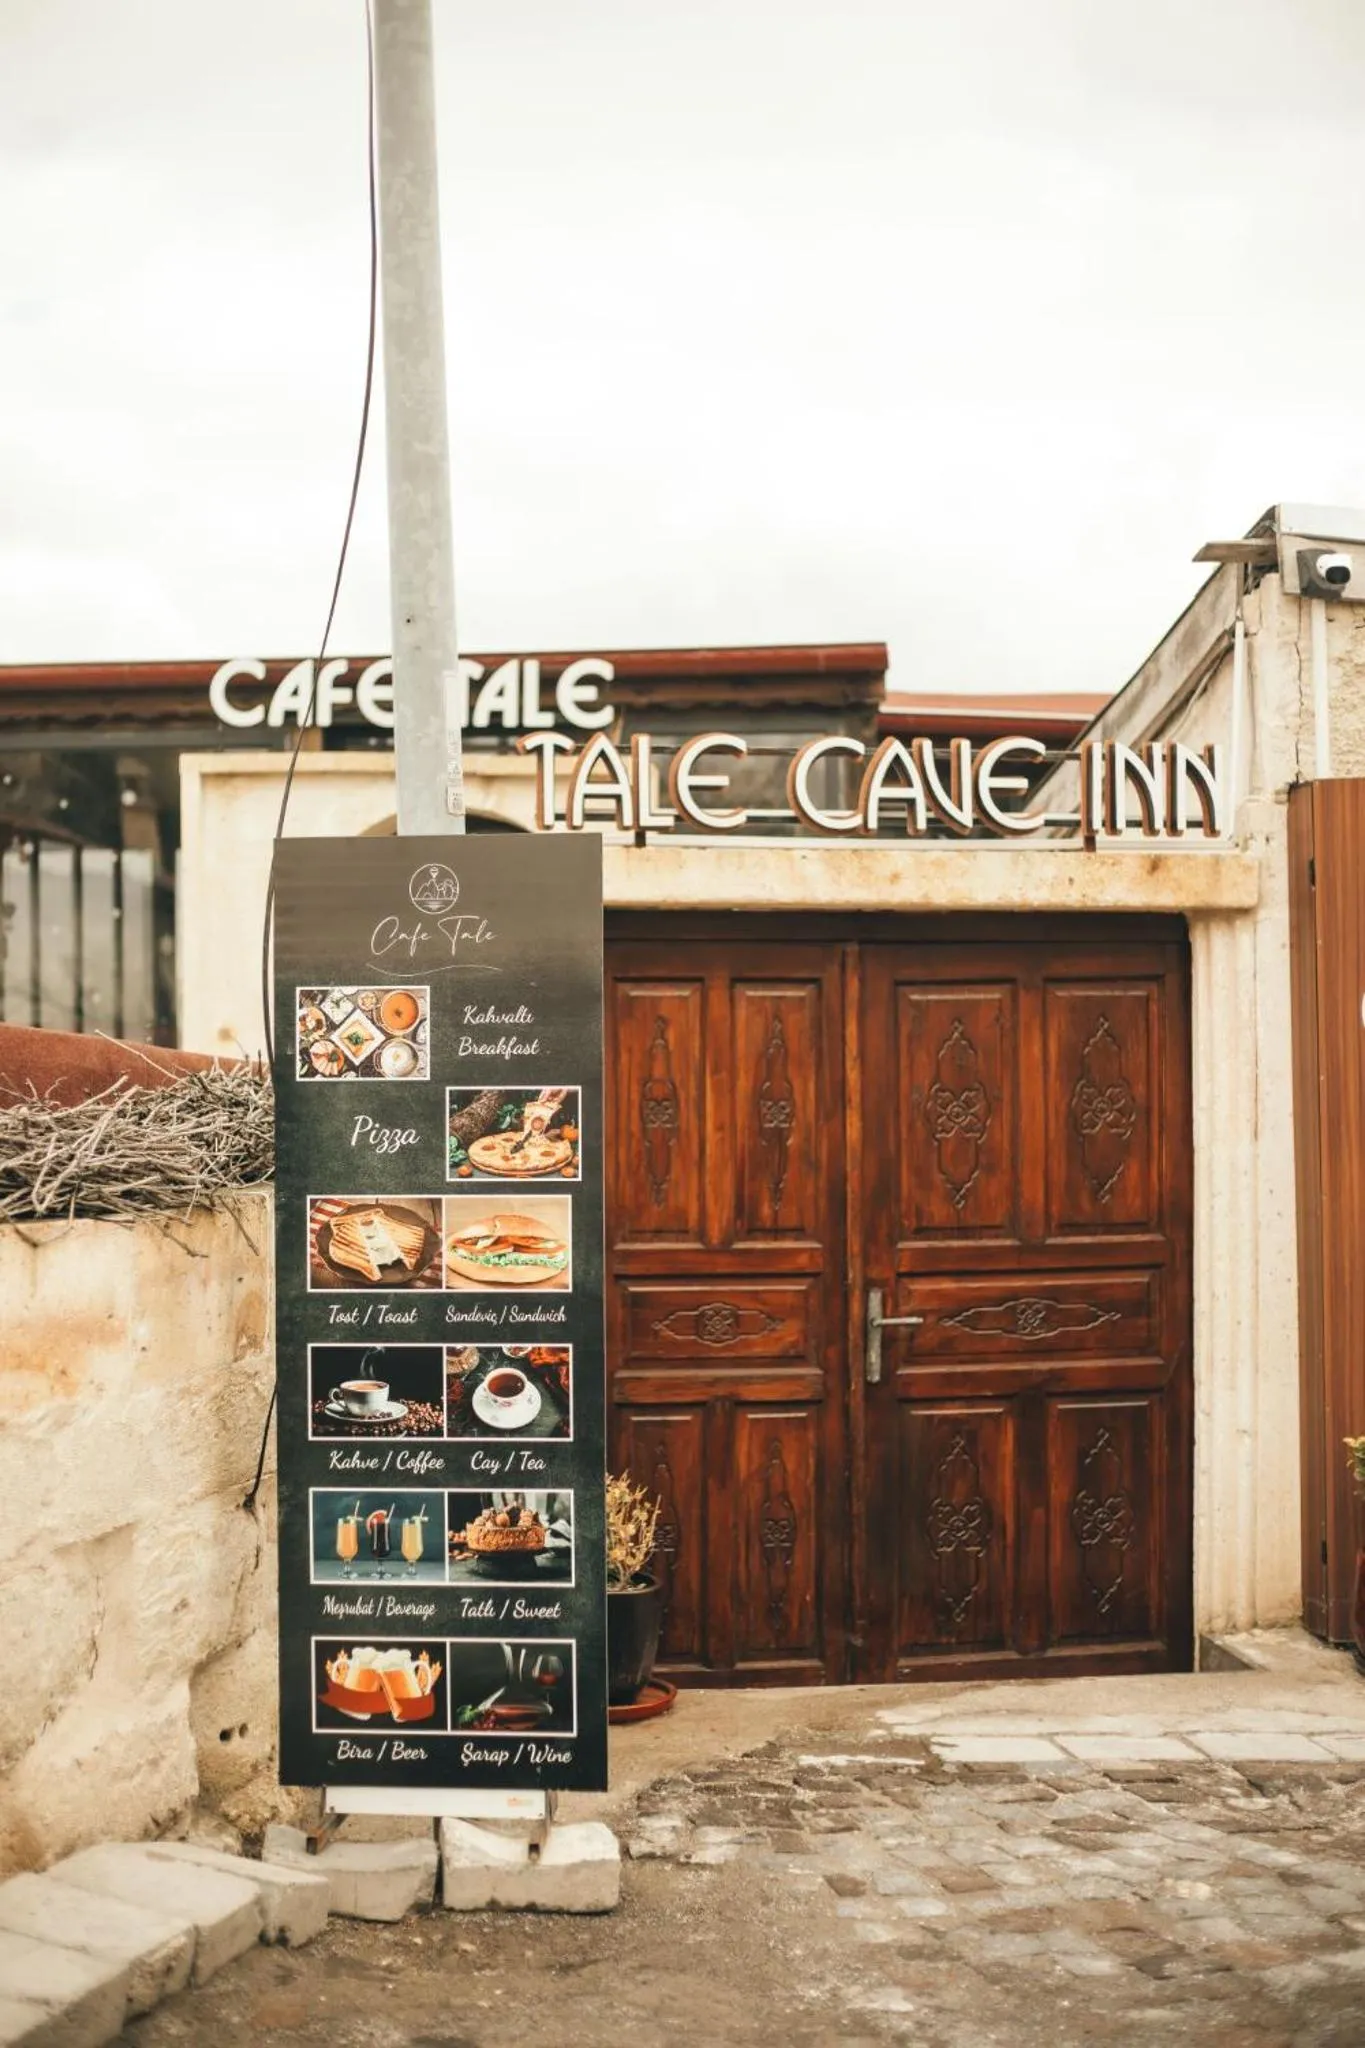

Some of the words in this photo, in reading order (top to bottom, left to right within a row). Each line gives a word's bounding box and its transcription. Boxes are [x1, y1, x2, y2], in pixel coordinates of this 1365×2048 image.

[209, 658, 394, 728] CAFE
[516, 730, 748, 832] TALE
[786, 734, 1047, 835] CAVE
[1081, 738, 1225, 837] INN
[370, 915, 432, 957] Cafe
[438, 914, 498, 957] Tale
[458, 1035, 540, 1060] Breakfast
[350, 1114, 421, 1154] Pizza
[328, 1304, 360, 1325] Tost
[376, 1304, 418, 1325] Toast
[508, 1304, 567, 1323] Sandwich
[329, 1450, 379, 1471] Kahve
[395, 1450, 445, 1474] Coffee
[518, 1450, 547, 1471] Tea
[385, 1595, 437, 1621] Beverage
[512, 1598, 562, 1619] Sweet
[337, 1740, 374, 1761] Bira
[390, 1741, 429, 1761] Beer
[460, 1742, 510, 1767] Şarap
[526, 1744, 573, 1765] Wine
